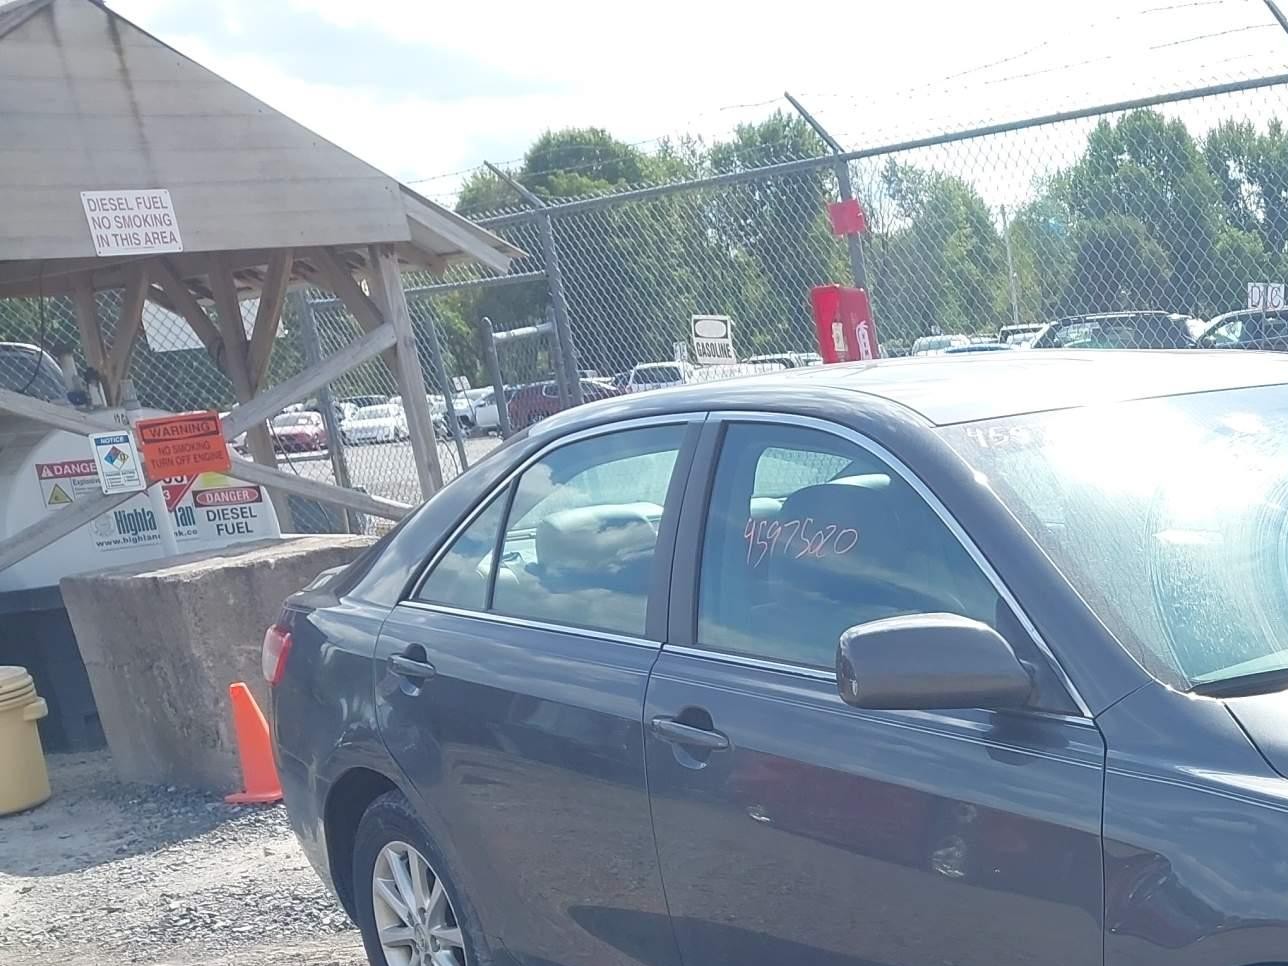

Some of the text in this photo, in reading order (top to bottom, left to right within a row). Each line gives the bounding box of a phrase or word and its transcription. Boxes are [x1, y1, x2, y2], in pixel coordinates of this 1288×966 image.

[87, 196, 168, 212] DIESEL FUEL
[91, 213, 173, 230] NO SMOKING
[96, 231, 178, 248] IN THIS AREA
[695, 341, 733, 359] GASOLINE
[148, 422, 210, 438] WARNING
[100, 435, 124, 444] NOTICE
[158, 440, 211, 456] NO SMOKING
[151, 450, 224, 469] TURN OFF ENGINE
[53, 462, 97, 475] DANGE
[206, 490, 249, 503] DANGER
[114, 508, 157, 536] Highla
[206, 506, 257, 522] DIESEL
[216, 522, 253, 536] FUEL
